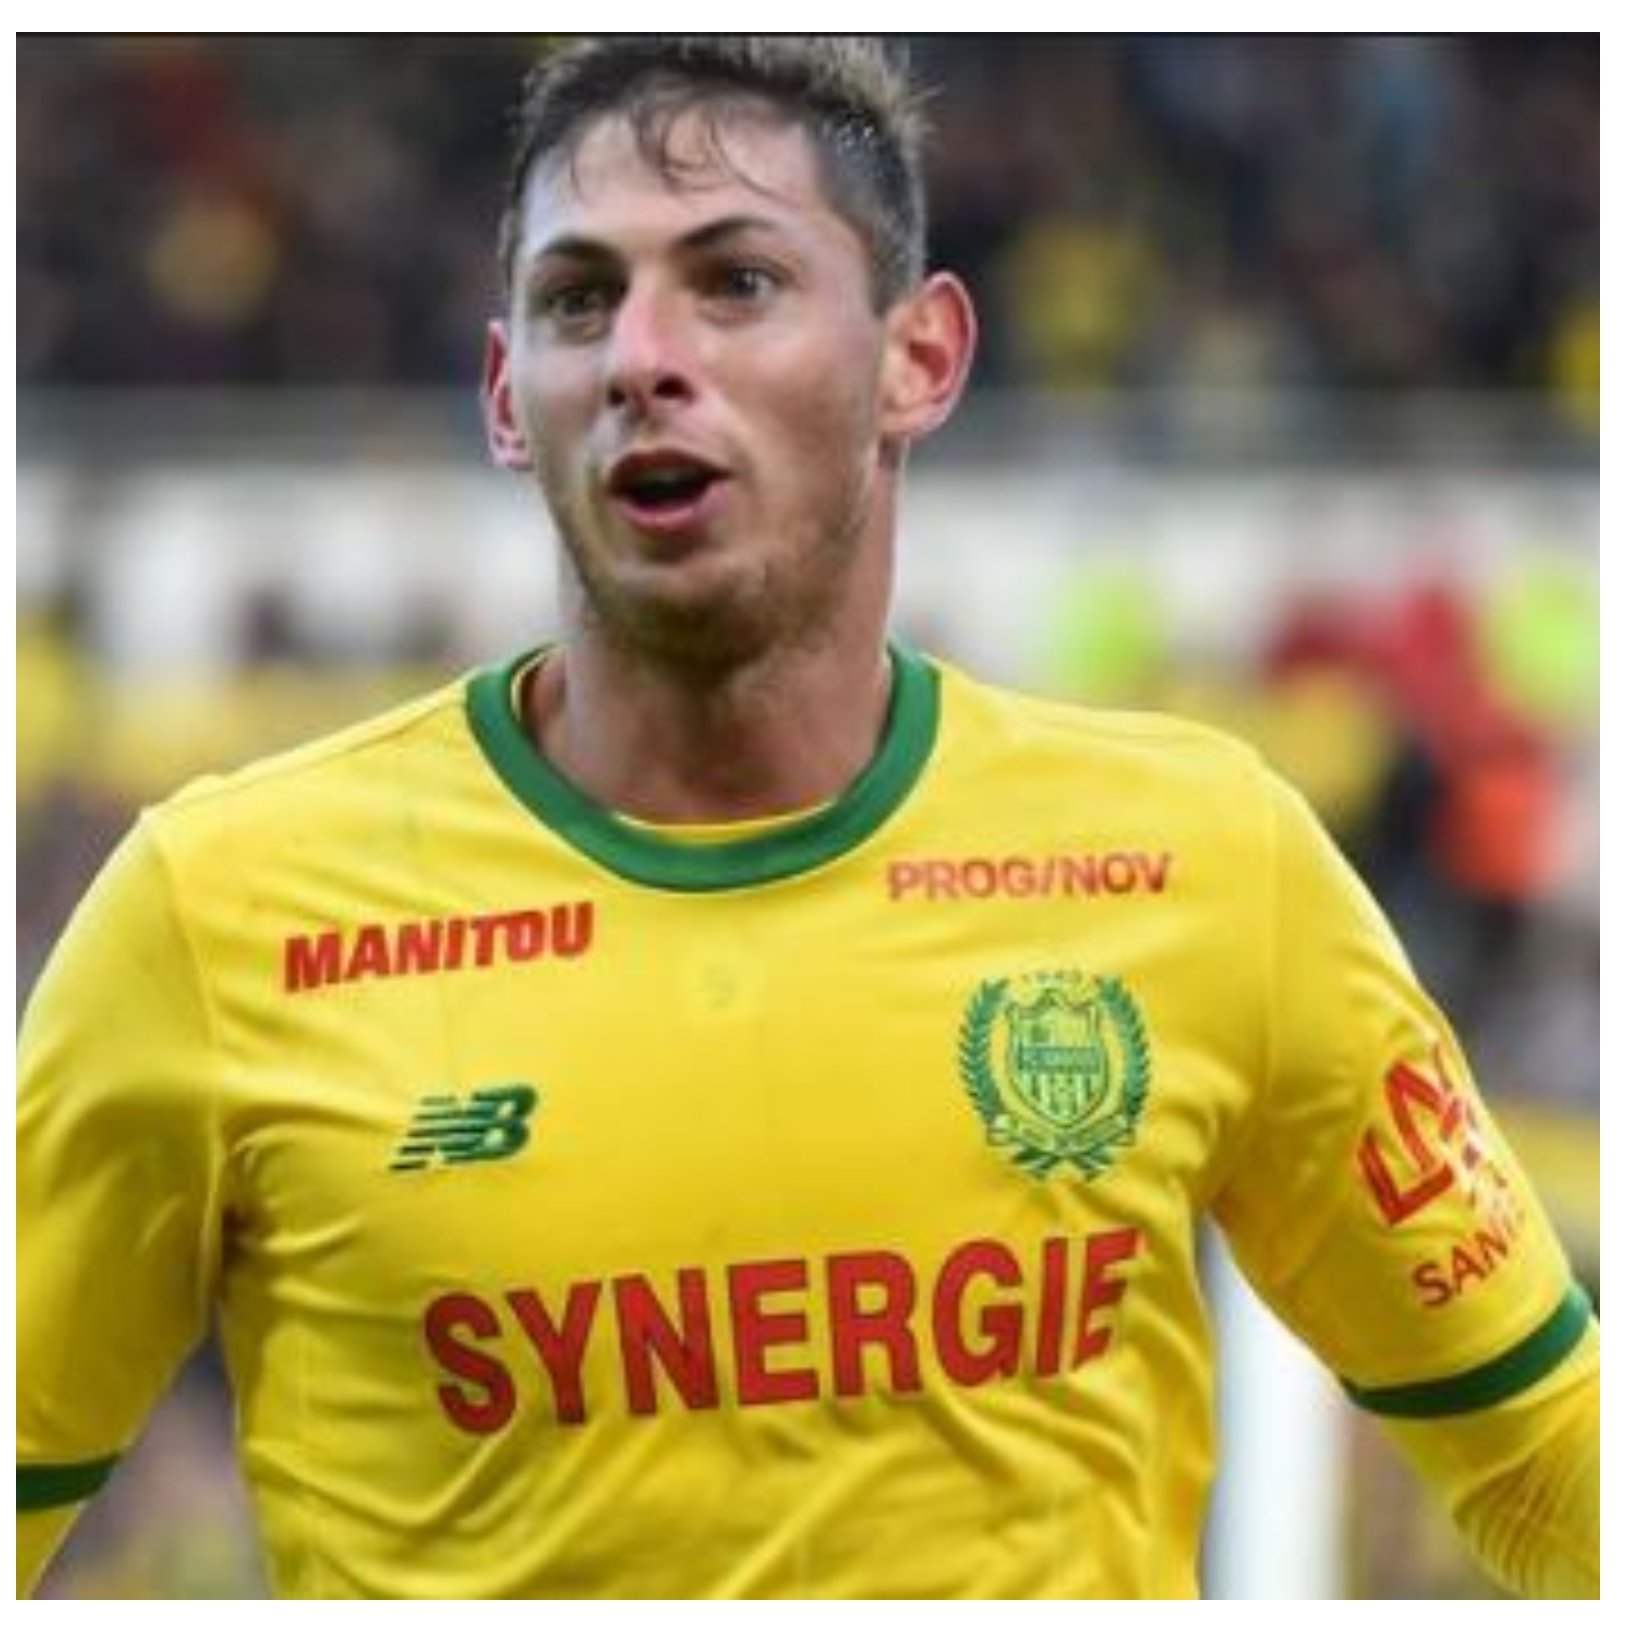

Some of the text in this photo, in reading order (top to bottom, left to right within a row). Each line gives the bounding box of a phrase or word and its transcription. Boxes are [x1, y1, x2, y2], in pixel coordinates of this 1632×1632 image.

[887, 852, 1172, 901] PROG/NOV
[284, 901, 594, 993] MANITOU
[423, 1228, 1142, 1436] SYNERGIE
